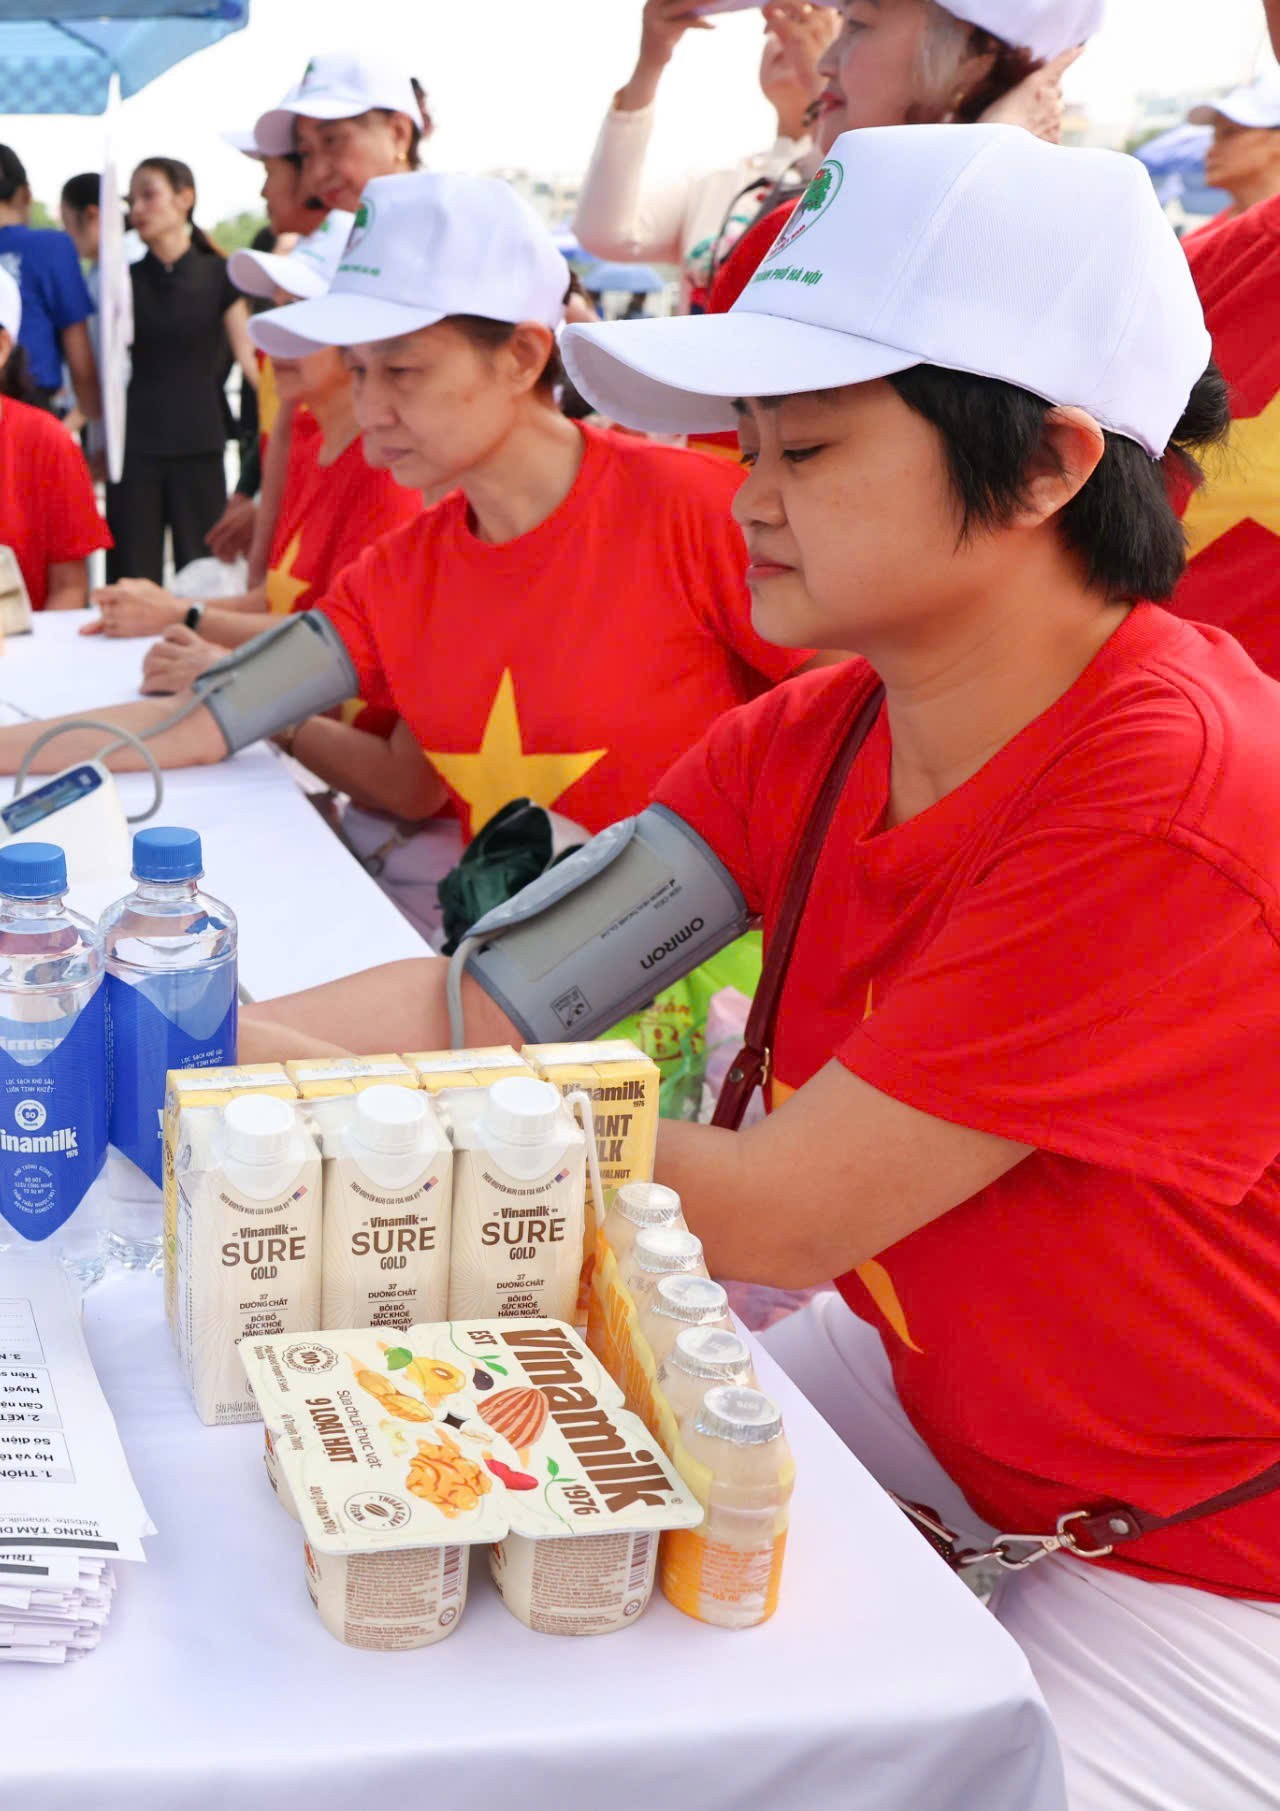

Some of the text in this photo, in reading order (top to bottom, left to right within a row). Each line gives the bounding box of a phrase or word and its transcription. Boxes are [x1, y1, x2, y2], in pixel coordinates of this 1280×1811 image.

[801, 269, 823, 286] NỘI
[500, 1205, 550, 1219] Vinamilk
[370, 1214, 419, 1228] Vinamilk
[239, 1223, 289, 1239] Vinamilk
[481, 1217, 566, 1246] SURE
[351, 1225, 436, 1256] SURE
[221, 1235, 306, 1267] SURE
[509, 1246, 536, 1261] GOLD
[380, 1255, 407, 1270] GOLD
[250, 1265, 278, 1280] GOLD
[10, 1370, 37, 1379] Tiền
[3, 1384, 40, 1394] Huyết
[19, 1401, 43, 1410] Cân
[336, 1389, 354, 1406] Sữa
[345, 1405, 361, 1427] chua
[27, 1414, 40, 1422] 2.
[466, 1329, 600, 1515] EST 1976
[500, 1327, 674, 1514] Vinamilk
[304, 1397, 358, 1463] 9 LOẠI HẠT
[2, 1436, 30, 1445] điện
[33, 1437, 51, 1445] Số
[16, 1453, 32, 1462] và
[34, 1451, 54, 1462] Họ
[40, 1469, 52, 1478] 1.
[55, 1517, 99, 1527] Website:
[16, 1525, 48, 1537] TÂM
[51, 1526, 102, 1538] TRUNG
